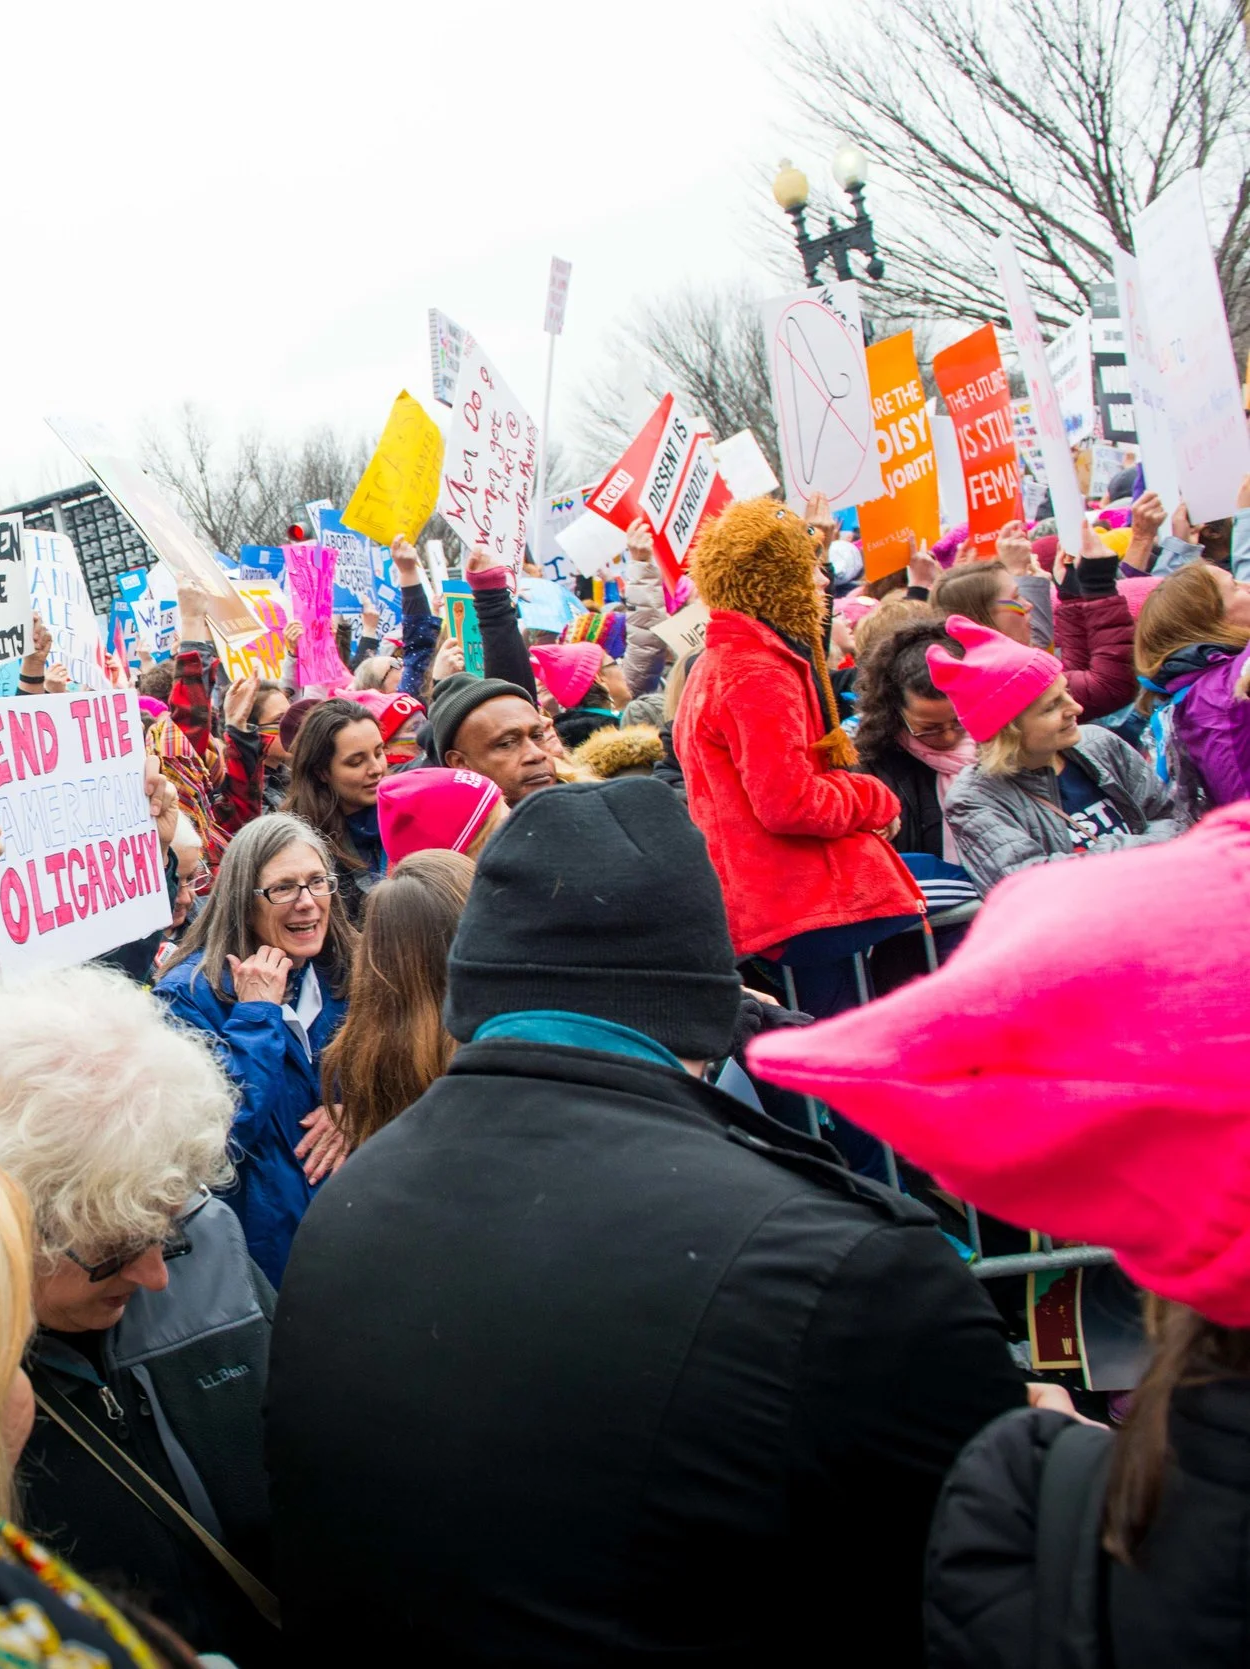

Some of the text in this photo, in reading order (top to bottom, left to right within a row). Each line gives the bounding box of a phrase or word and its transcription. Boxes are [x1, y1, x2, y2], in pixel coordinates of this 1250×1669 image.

[895, 380, 921, 412] THE
[945, 368, 1008, 414] THE FUTURE
[875, 408, 927, 463] OISY
[958, 424, 979, 461] IS
[600, 472, 630, 510] ACLU
[648, 417, 688, 515] DISSENT IS
[880, 450, 934, 499] JORITY
[970, 461, 1019, 511] FEMA
[672, 455, 710, 544] PATRIOTIC
[70, 693, 134, 764] THE
[0, 829, 163, 945] OLIGARCHY
